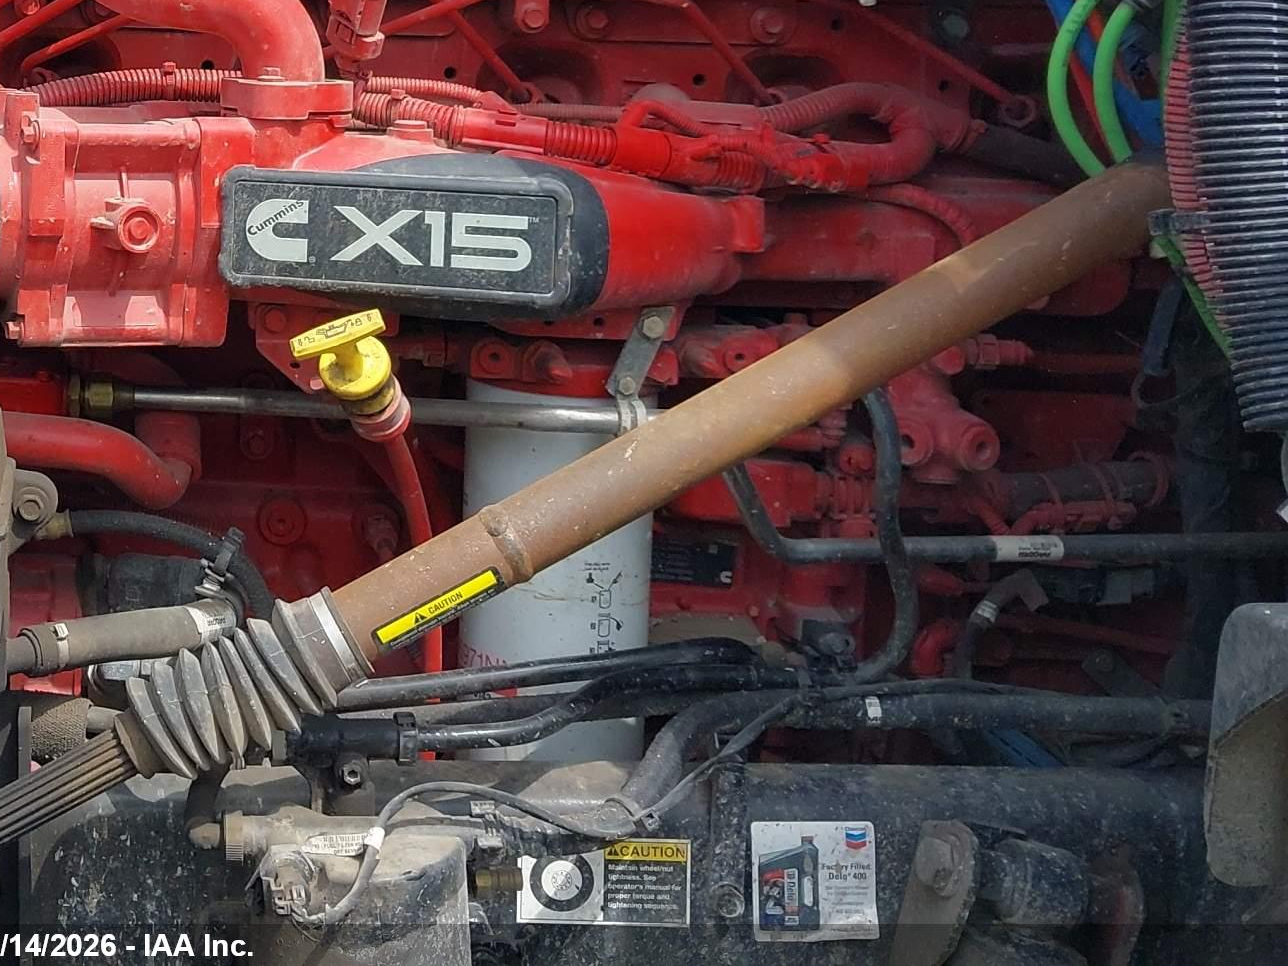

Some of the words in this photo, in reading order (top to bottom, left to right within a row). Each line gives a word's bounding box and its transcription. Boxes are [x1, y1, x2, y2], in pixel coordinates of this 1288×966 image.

[427, 591, 463, 614] CAUTION
[620, 845, 685, 858] CAUTION
[607, 893, 631, 901] proper
